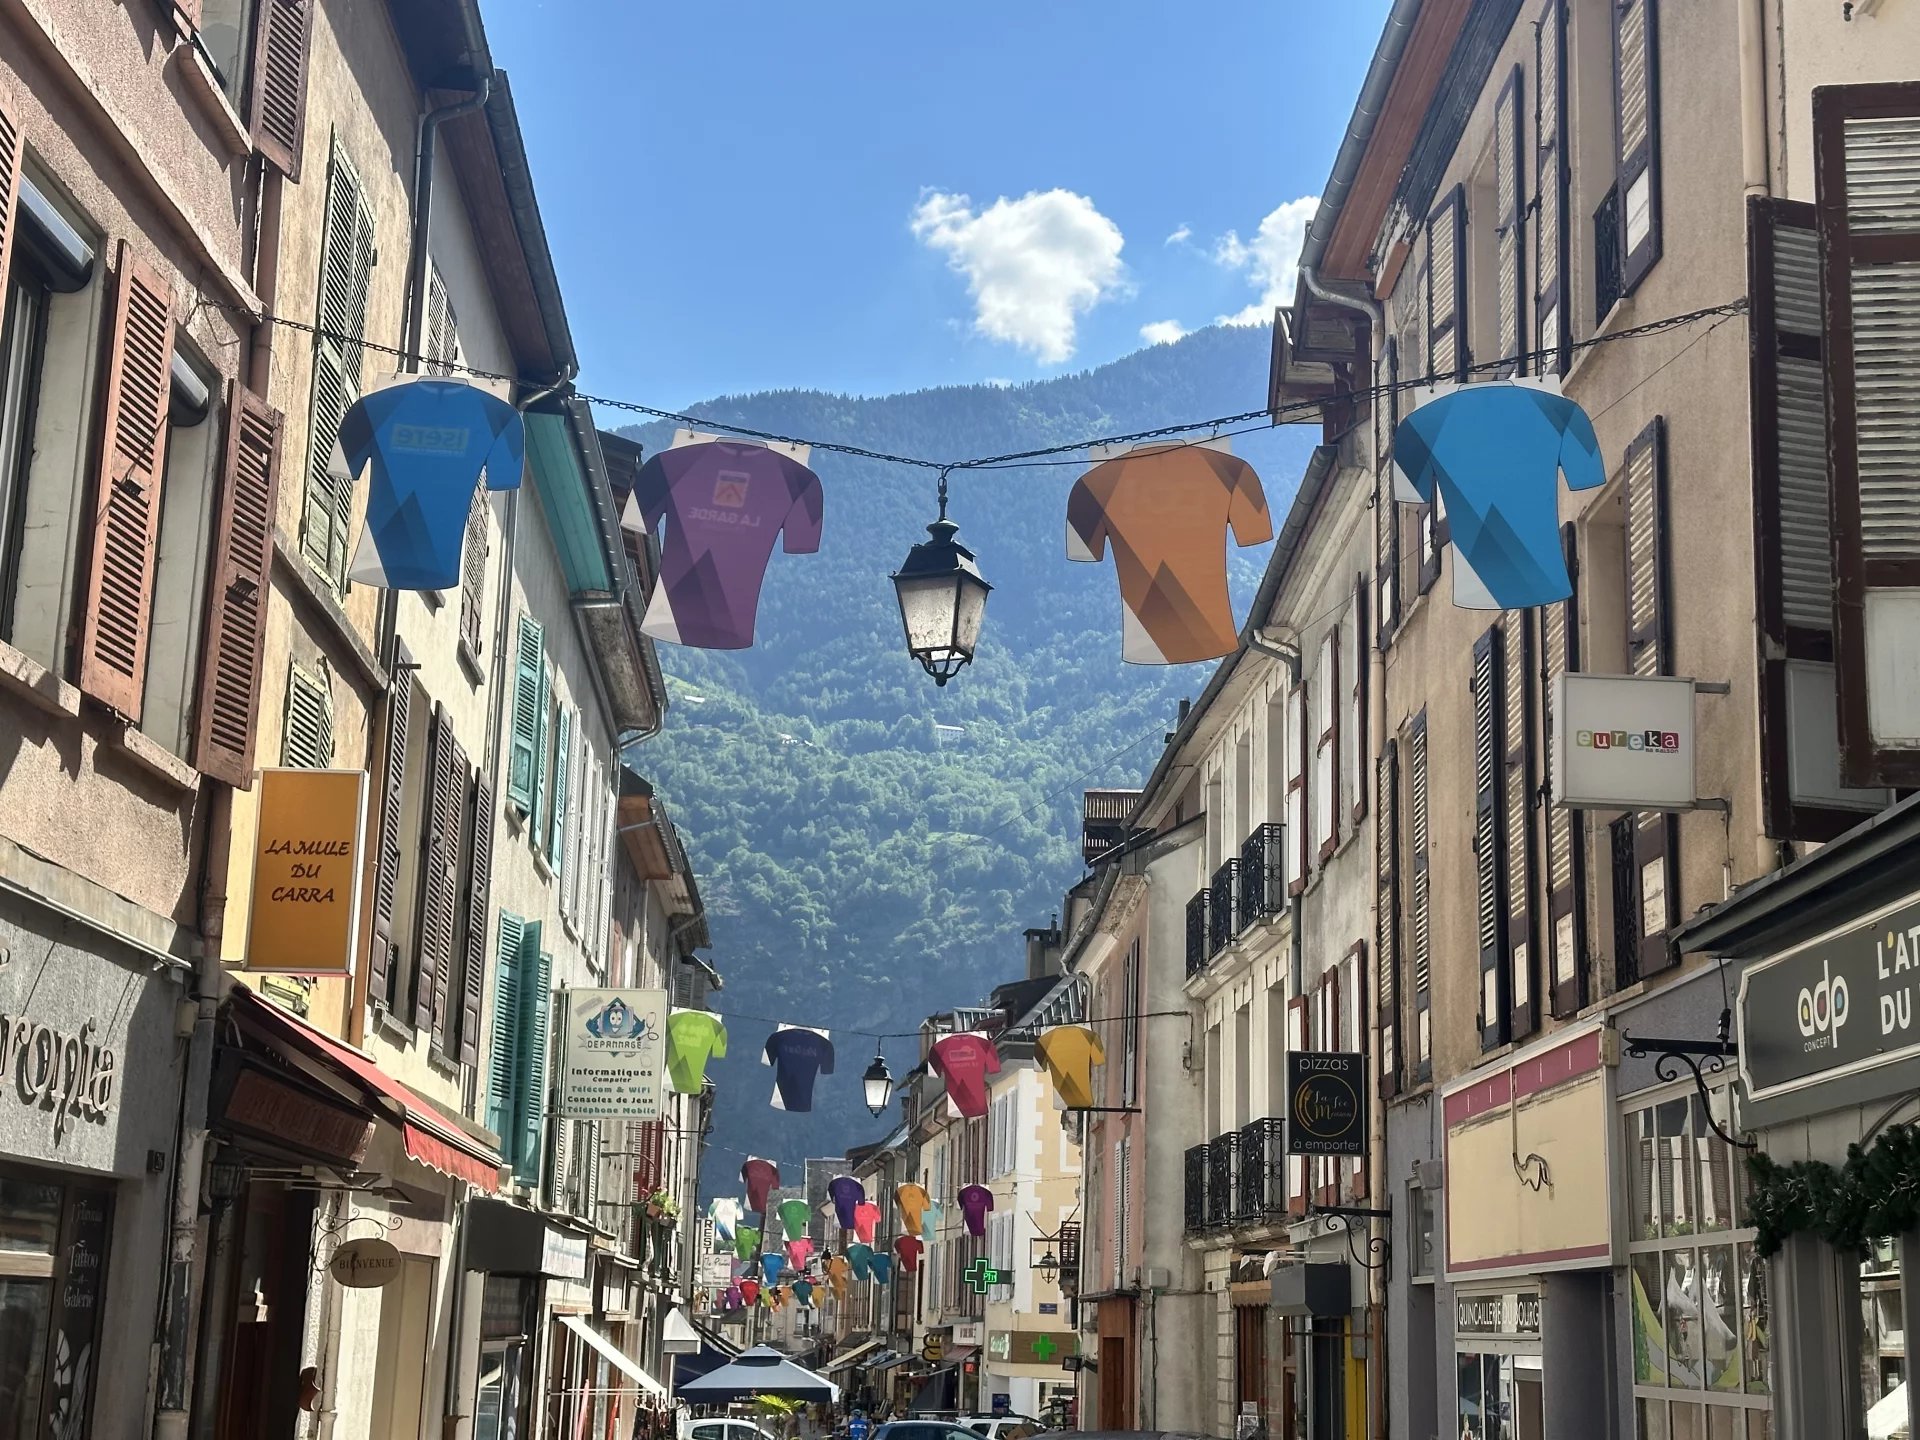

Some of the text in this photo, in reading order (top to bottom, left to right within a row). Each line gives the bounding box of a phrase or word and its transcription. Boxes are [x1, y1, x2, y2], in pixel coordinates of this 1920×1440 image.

[1577, 731, 1678, 750] eureka
[264, 839, 350, 857] LA MULE
[290, 863, 322, 879] DU
[271, 886, 335, 903] CARRA
[1797, 959, 1849, 1049] adp
[1880, 987, 1912, 1036] DU
[1804, 1035, 1832, 1053] CONCEPT
[571, 1068, 653, 1077] Informatiques
[1299, 1055, 1349, 1072] pizzas
[567, 1096, 612, 1104] Consoles
[1293, 1138, 1360, 1151] à emporter
[68, 1240, 99, 1274] Tattoo
[63, 1285, 94, 1309] Galerie
[1458, 1301, 1540, 1326] QUINCAILLERIE DU BOURG
